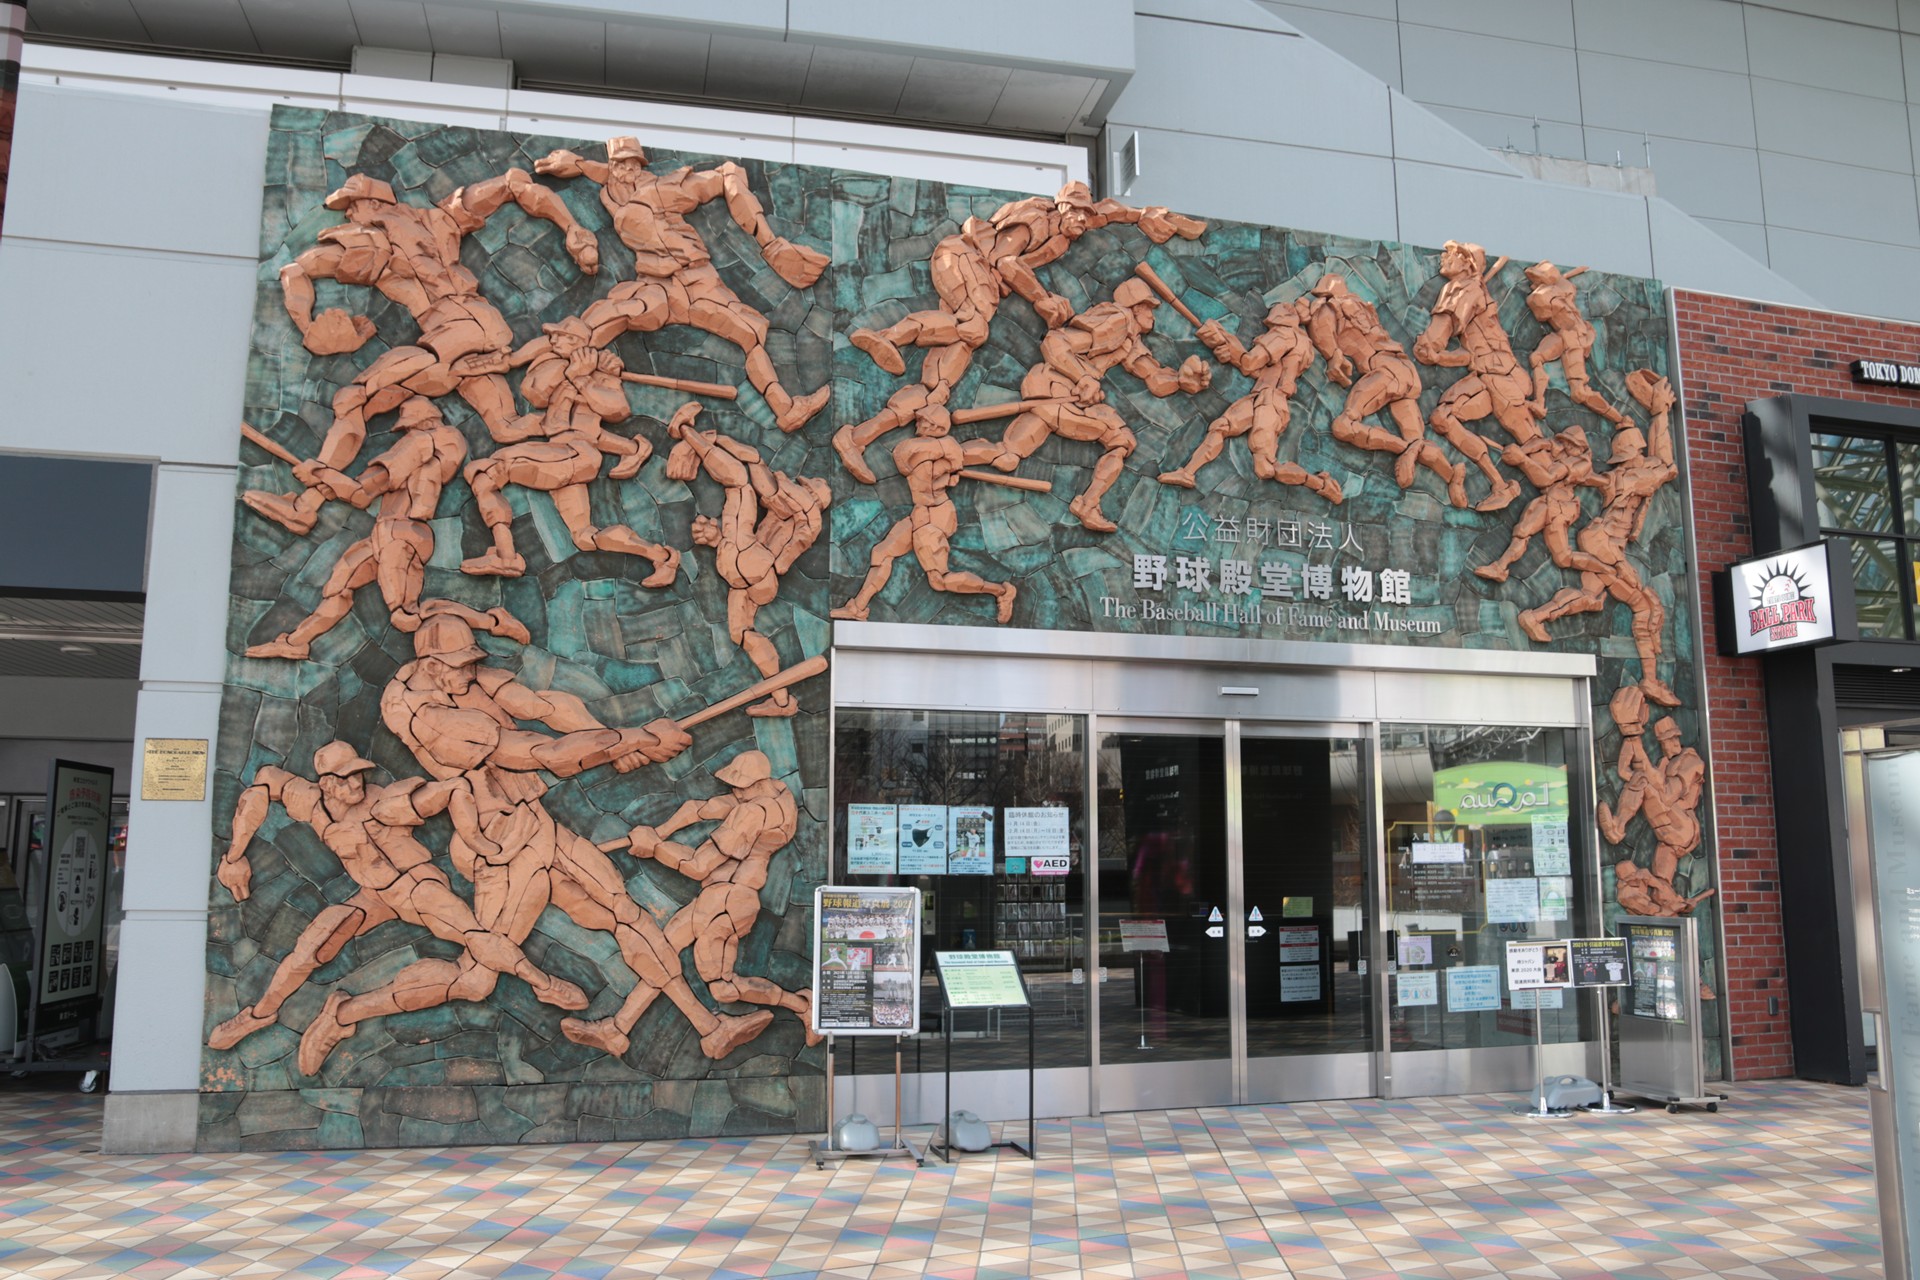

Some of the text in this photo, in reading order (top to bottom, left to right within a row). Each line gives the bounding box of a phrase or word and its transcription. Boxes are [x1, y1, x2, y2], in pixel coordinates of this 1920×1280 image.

[1861, 361, 1899, 382] TOKYO
[1182, 512, 1364, 552] 公益財団法人
[1133, 554, 1411, 605] 野球殿堂博物館
[1100, 596, 1442, 633] The Baseball Hall of Fame and Museum
[1750, 598, 1817, 636] BALL PARK
[1769, 623, 1798, 641] STORE
[1043, 859, 1068, 868] AED
